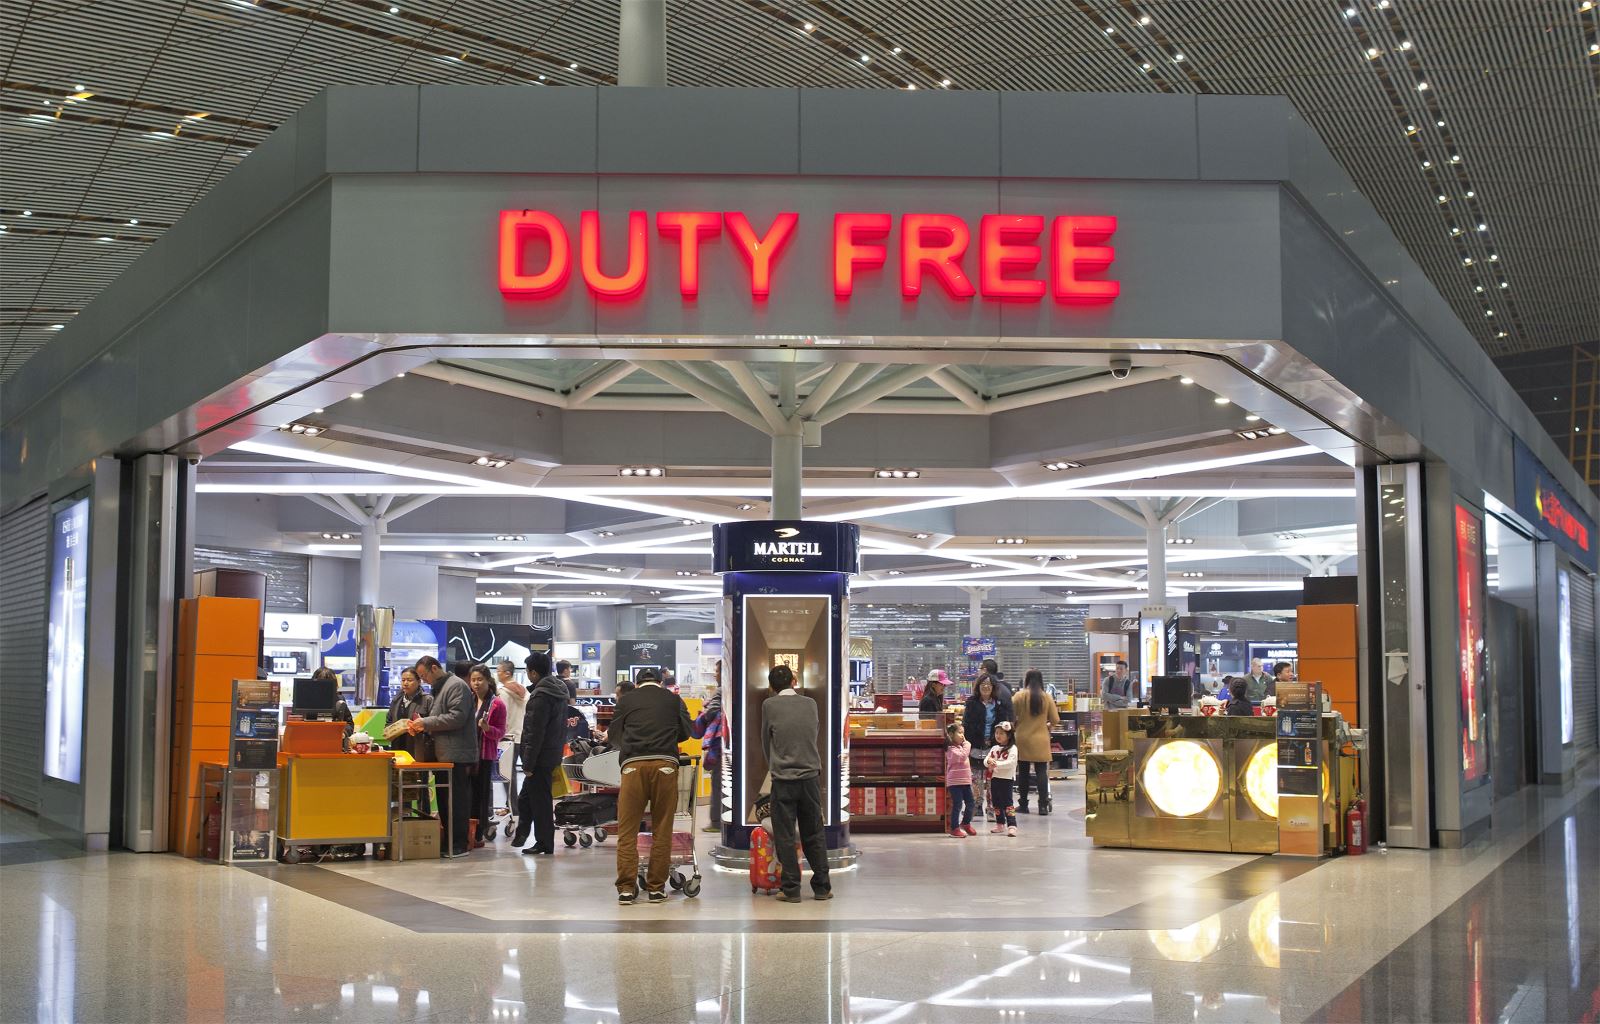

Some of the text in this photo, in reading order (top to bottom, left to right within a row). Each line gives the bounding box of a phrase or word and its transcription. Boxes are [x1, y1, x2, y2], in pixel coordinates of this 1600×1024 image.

[499, 209, 1121, 300] DUTY FREE
[753, 542, 822, 556] MARTELL
